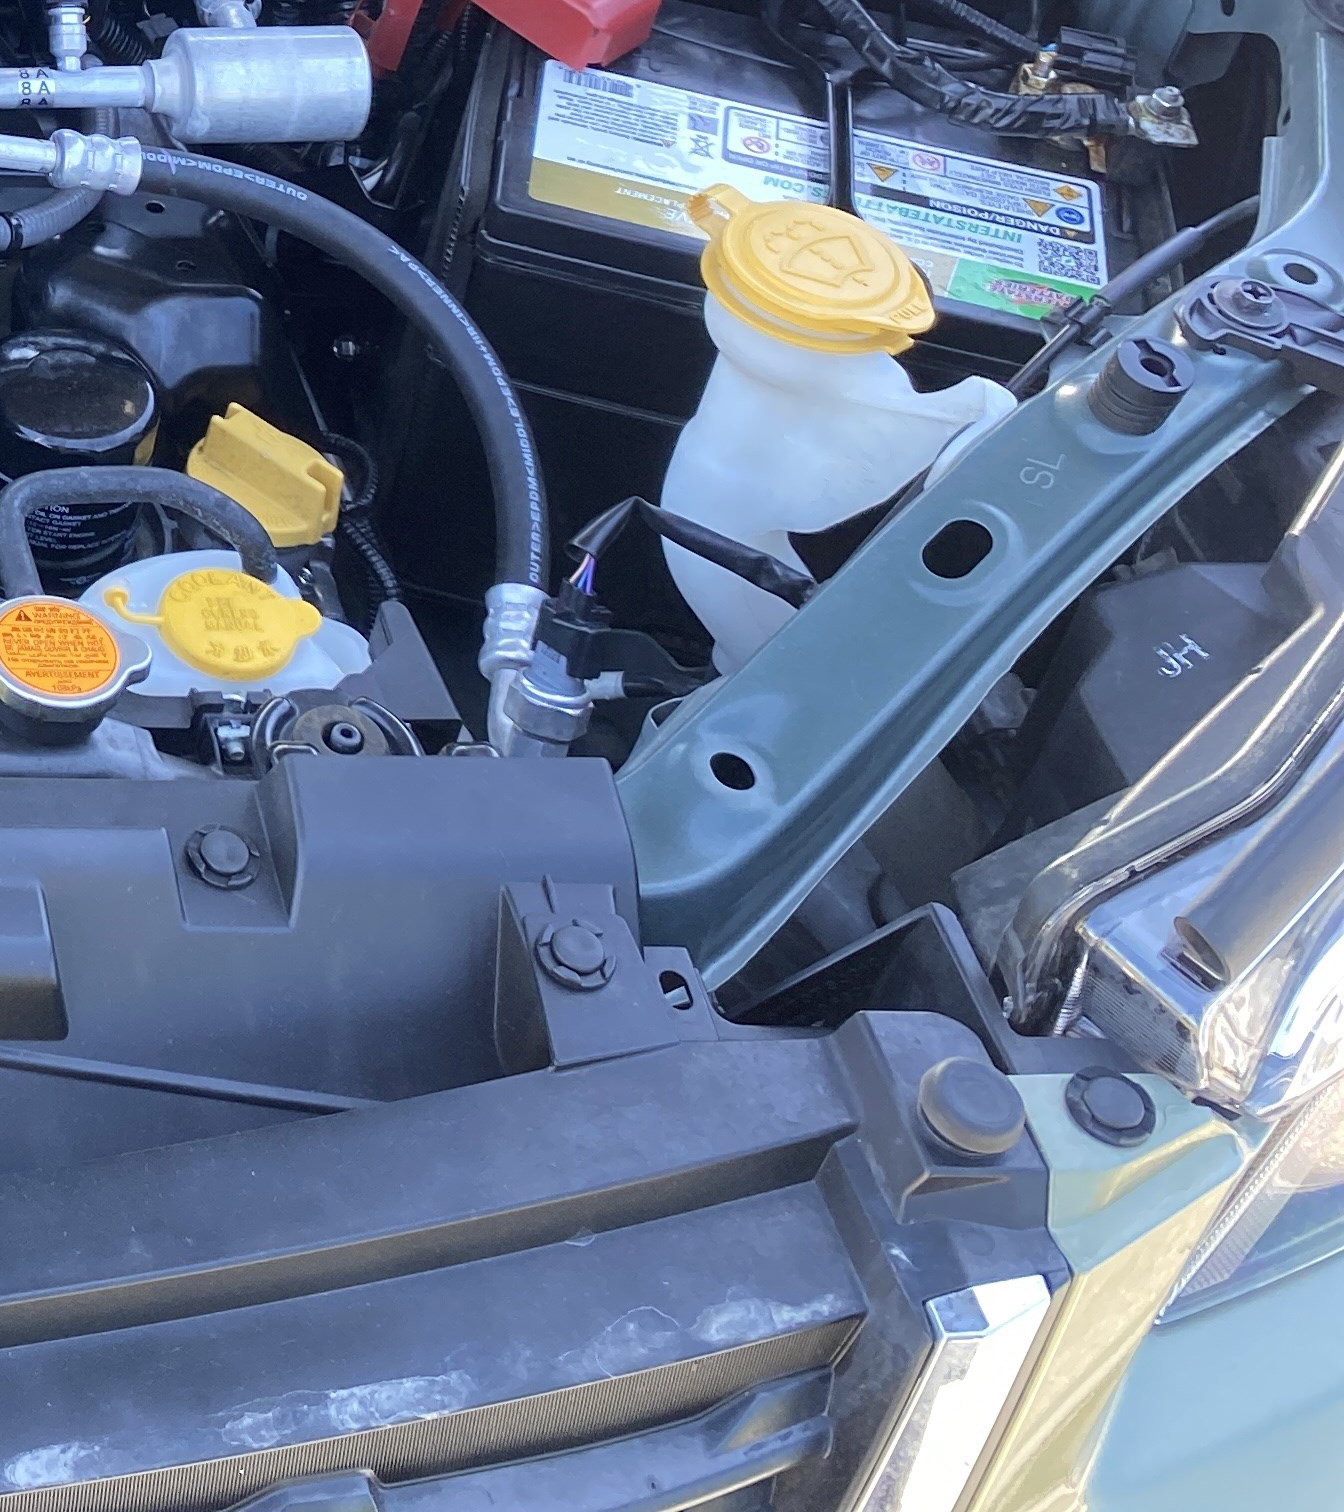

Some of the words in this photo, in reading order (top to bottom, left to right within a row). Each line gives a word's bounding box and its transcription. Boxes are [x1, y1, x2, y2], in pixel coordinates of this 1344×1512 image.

[929, 199, 1061, 236] DANGER/POISON
[1019, 453, 1066, 489] SL
[169, 571, 277, 603] COOLANT
